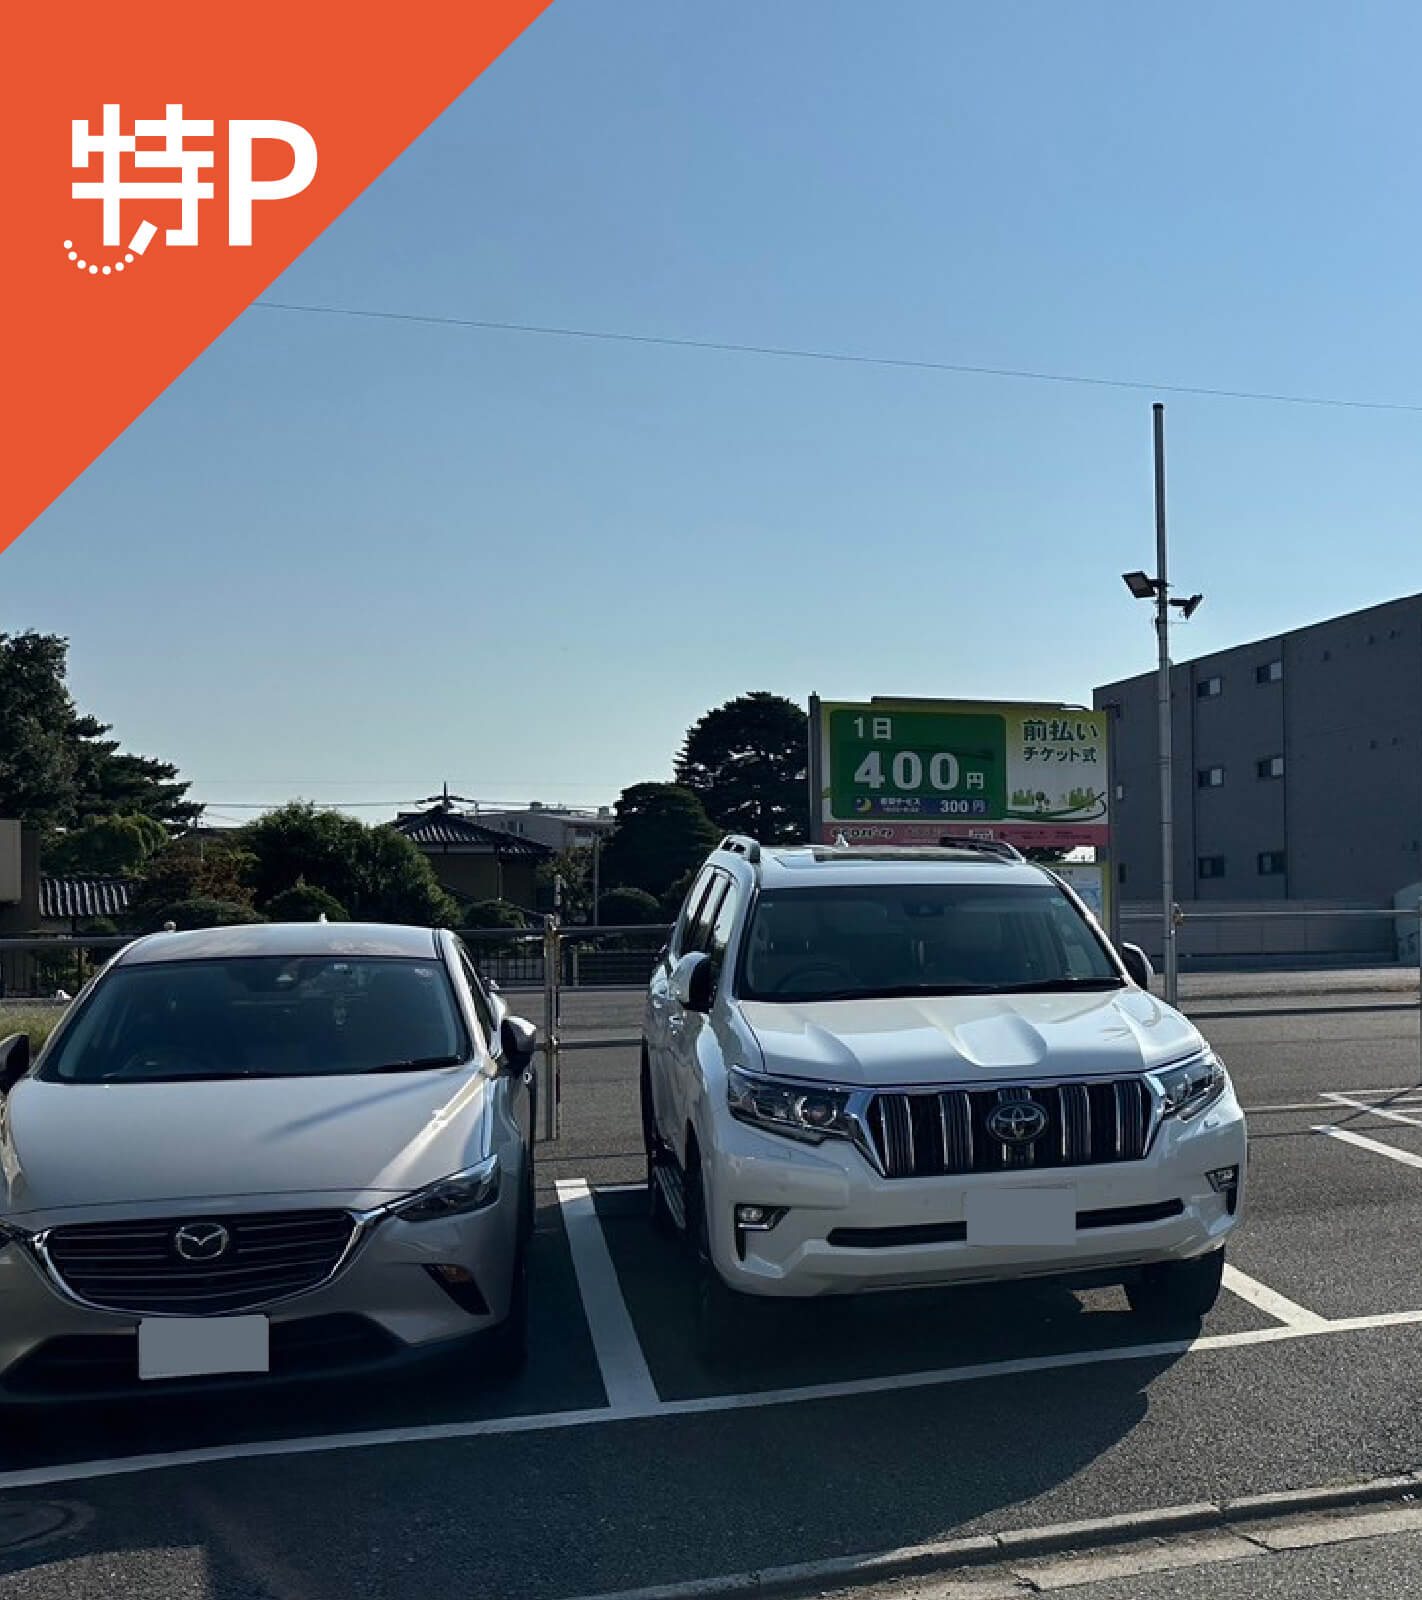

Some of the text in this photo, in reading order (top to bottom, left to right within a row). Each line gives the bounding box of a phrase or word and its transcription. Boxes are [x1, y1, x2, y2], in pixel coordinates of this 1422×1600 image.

[854, 717, 892, 740] 1日
[1023, 720, 1098, 742] 前払い
[1023, 747, 1097, 763] チケット式
[854, 751, 984, 790] 400円
